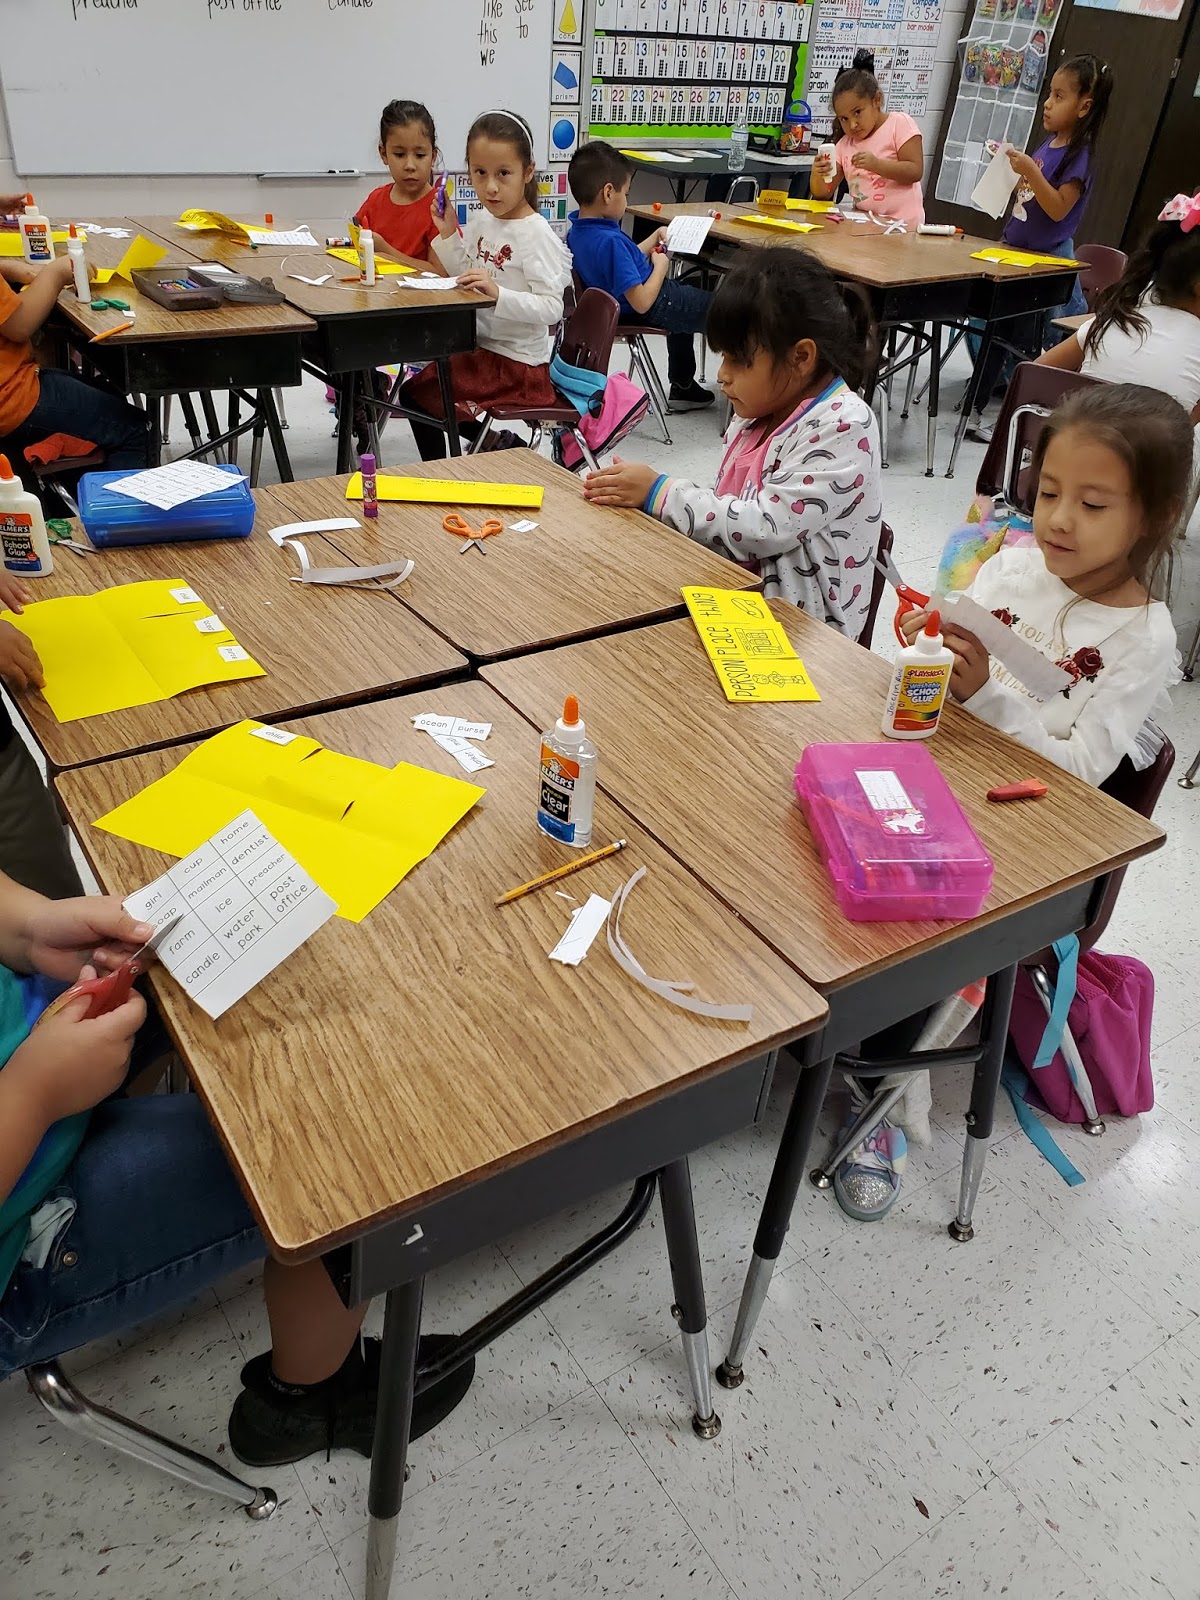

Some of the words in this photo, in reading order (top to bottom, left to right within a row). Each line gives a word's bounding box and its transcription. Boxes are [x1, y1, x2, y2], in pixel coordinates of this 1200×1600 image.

[483, 0, 503, 18] like
[661, 0, 667, 10] 3
[682, 0, 688, 11] 4
[701, 1, 708, 13] 5
[721, 2, 728, 15] 6
[741, 3, 747, 16] 7
[759, 4, 765, 17] 8
[777, 6, 783, 19] 9
[794, 8, 805, 21] 10
[477, 20, 498, 44] this
[516, 16, 529, 39] to
[860, 21, 881, 30] number
[882, 21, 896, 30] bond
[906, 23, 917, 31] bar
[918, 23, 935, 32] model
[480, 49, 496, 66] we
[595, 41, 605, 55] 11
[615, 42, 627, 55] 12
[636, 42, 648, 56] 13
[657, 43, 668, 57] 14
[677, 44, 688, 58] 15
[696, 45, 707, 59] 16
[716, 46, 726, 59] 17
[735, 47, 746, 61] 18
[755, 48, 766, 61] 19
[774, 49, 786, 62] 20
[895, 57, 909, 67] plot
[892, 72, 905, 81] key
[808, 80, 829, 91] graph
[555, 93, 575, 101] prism
[592, 88, 602, 102] 21
[612, 89, 625, 102] 22
[632, 89, 645, 102] 23
[653, 90, 665, 103] 24
[672, 90, 684, 103] 25
[690, 91, 703, 103] 26
[709, 91, 721, 104] 27
[729, 91, 741, 104] 28
[748, 91, 760, 104] 29
[768, 92, 780, 105] 30
[0, 525, 28, 533] ELMER'S
[4, 540, 31, 550] School
[8, 548, 26, 557] Glue
[1018, 622, 1046, 643] YOU
[911, 695, 935, 703] GLUE
[265, 731, 287, 739] child
[420, 719, 448, 728] ocean
[457, 725, 485, 734] purse
[541, 764, 574, 790] ELMER'S
[541, 789, 568, 813] Clear
[144, 891, 163, 911] girl
[183, 856, 203, 875] cup
[220, 820, 250, 845] home
[154, 907, 177, 929] soap
[187, 866, 227, 900] mailman
[231, 833, 270, 866] dentist
[168, 929, 196, 955] farm
[214, 896, 233, 914] ice
[247, 853, 287, 887] preacher
[237, 924, 264, 950] park
[276, 882, 309, 914] office
[185, 951, 221, 984] candle
[223, 907, 256, 940] water
[269, 875, 296, 901] post
